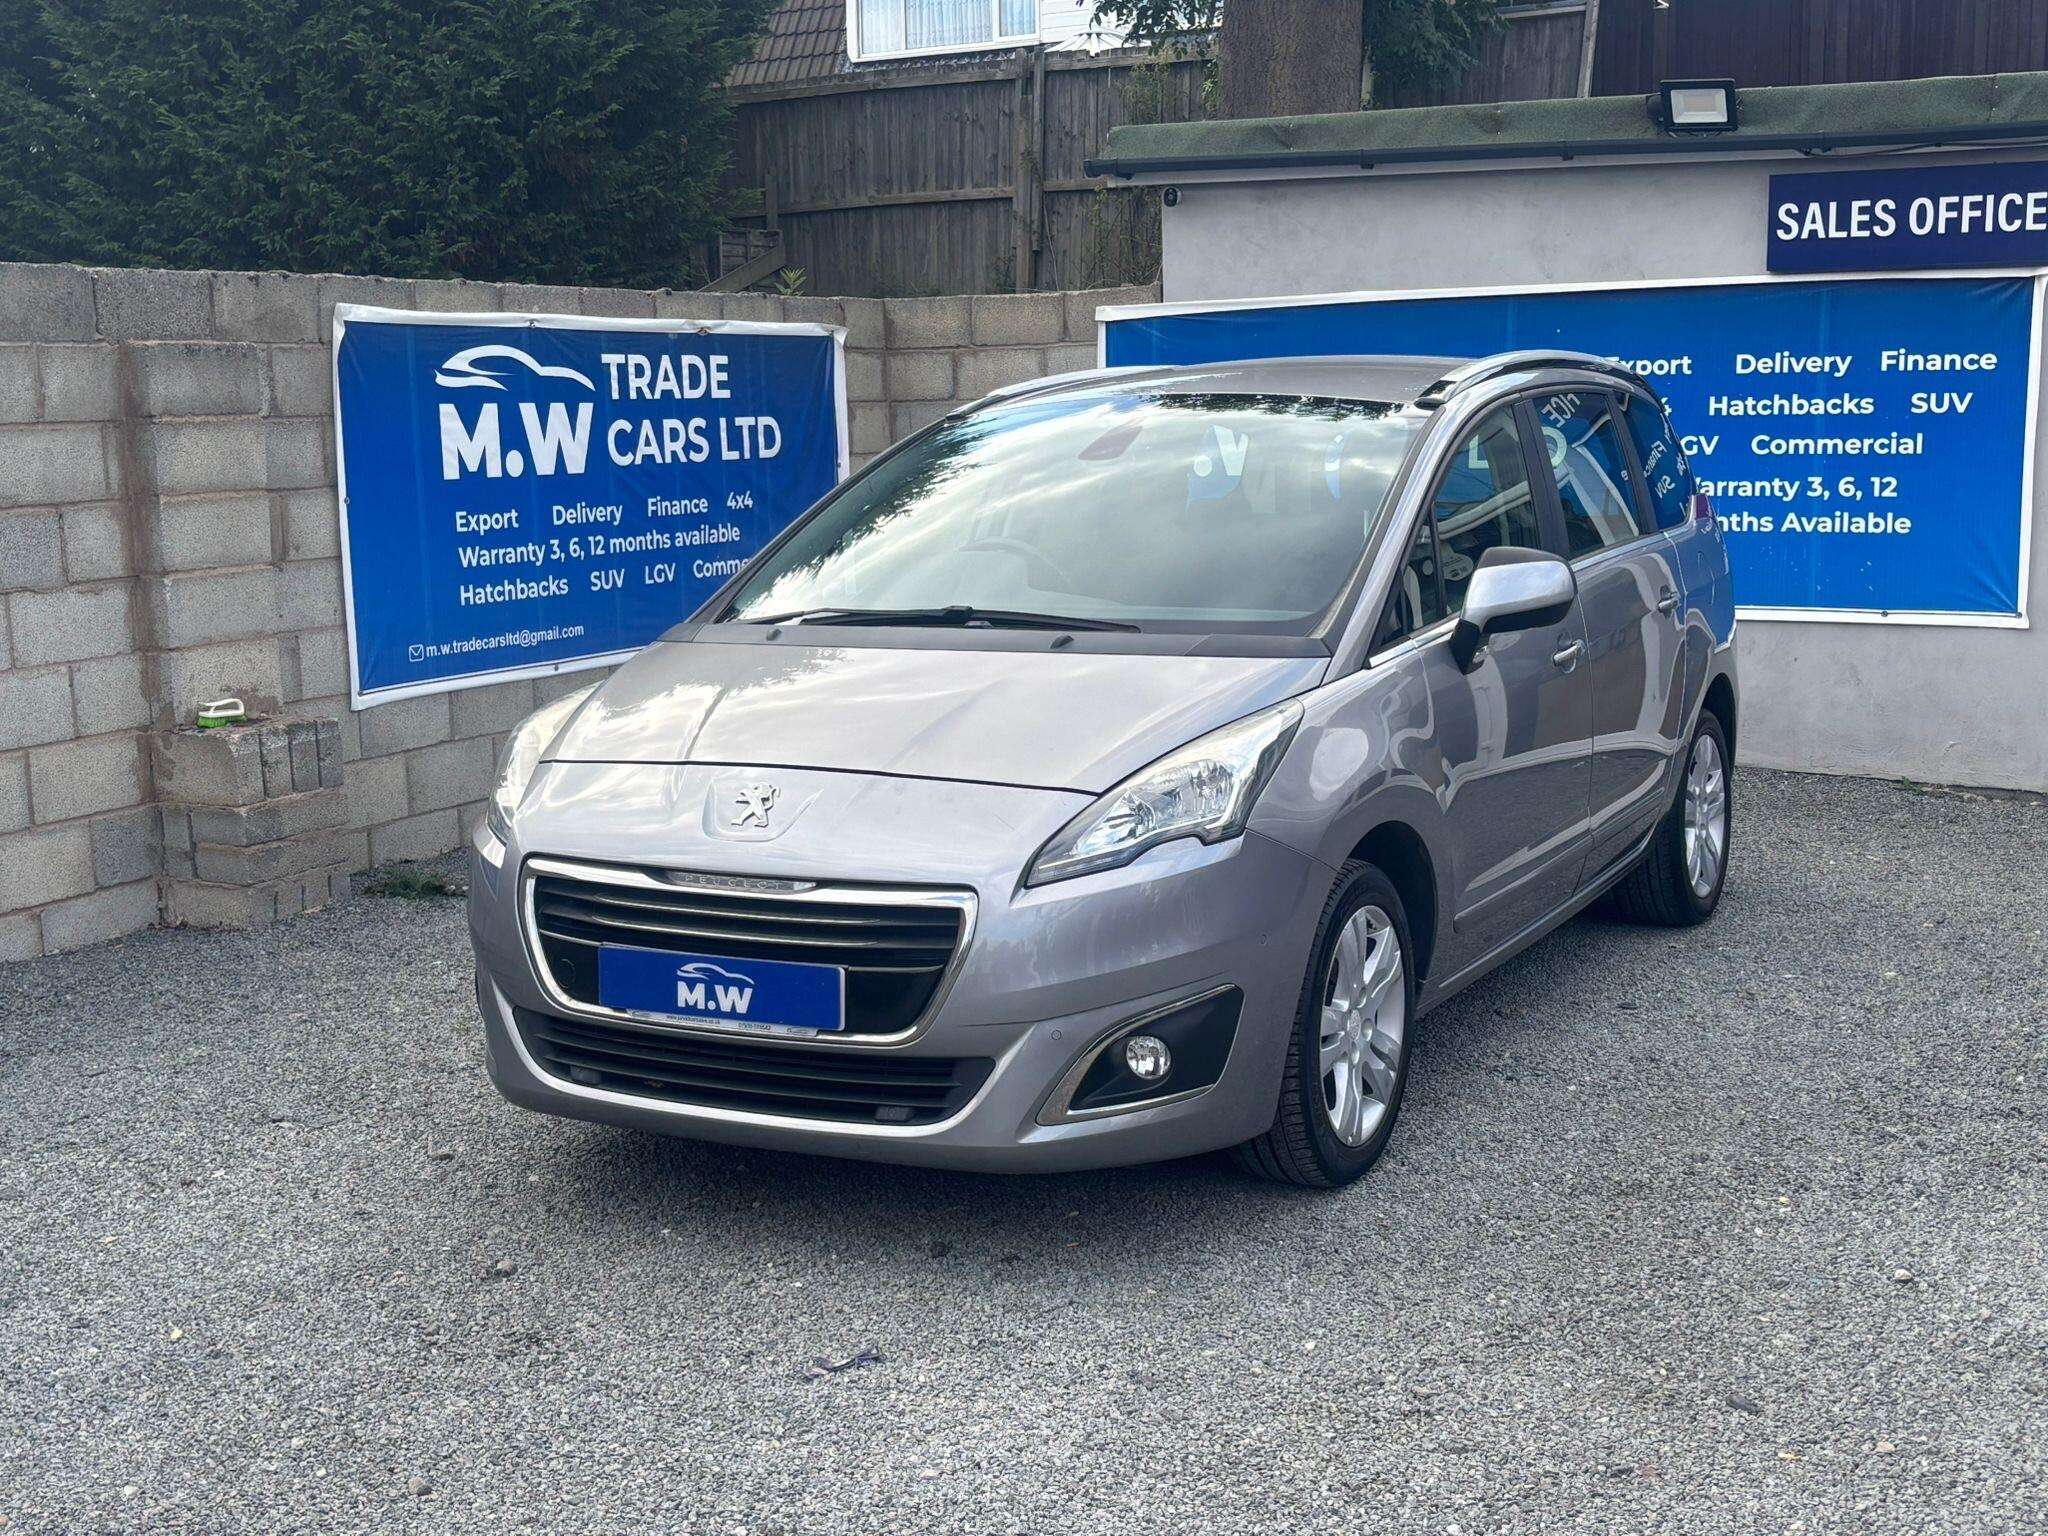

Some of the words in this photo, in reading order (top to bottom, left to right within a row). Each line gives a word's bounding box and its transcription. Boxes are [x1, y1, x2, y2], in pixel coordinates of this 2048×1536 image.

[1776, 198, 1896, 241] SALES
[1909, 191, 2048, 236] OFFICE
[600, 353, 731, 400] TRADE
[1735, 350, 1853, 378] Delivery
[1881, 348, 1998, 372] Finance
[1709, 392, 1875, 416] Hatchbacks
[1910, 392, 1974, 414] SUV
[438, 402, 594, 480] M.W
[607, 417, 710, 466] CARS
[719, 416, 782, 461] LTD
[1678, 435, 1720, 457] GV
[1751, 431, 1923, 455] Commercial
[1696, 476, 1800, 502] arranty
[1806, 476, 1830, 501] 3,
[1838, 476, 1863, 501] 6,
[1870, 476, 1898, 497] 12
[455, 509, 519, 536] Export
[552, 501, 623, 526] Delivery
[648, 495, 708, 517] Finance
[726, 490, 753, 510] 4x4
[1716, 510, 1775, 533] nths
[1780, 510, 1912, 534] Available
[458, 541, 545, 567] Warranty
[549, 539, 565, 562] 3,
[569, 537, 585, 560] 6,
[588, 535, 606, 556] 12
[609, 529, 671, 554] months
[675, 523, 740, 547] available
[460, 575, 569, 606] Hatchbacks
[590, 568, 625, 591] SUV
[645, 563, 676, 584] LGV
[426, 624, 583, 655] m.w.tradecarsltd@gmail.com
[676, 980, 754, 1014] M.W
